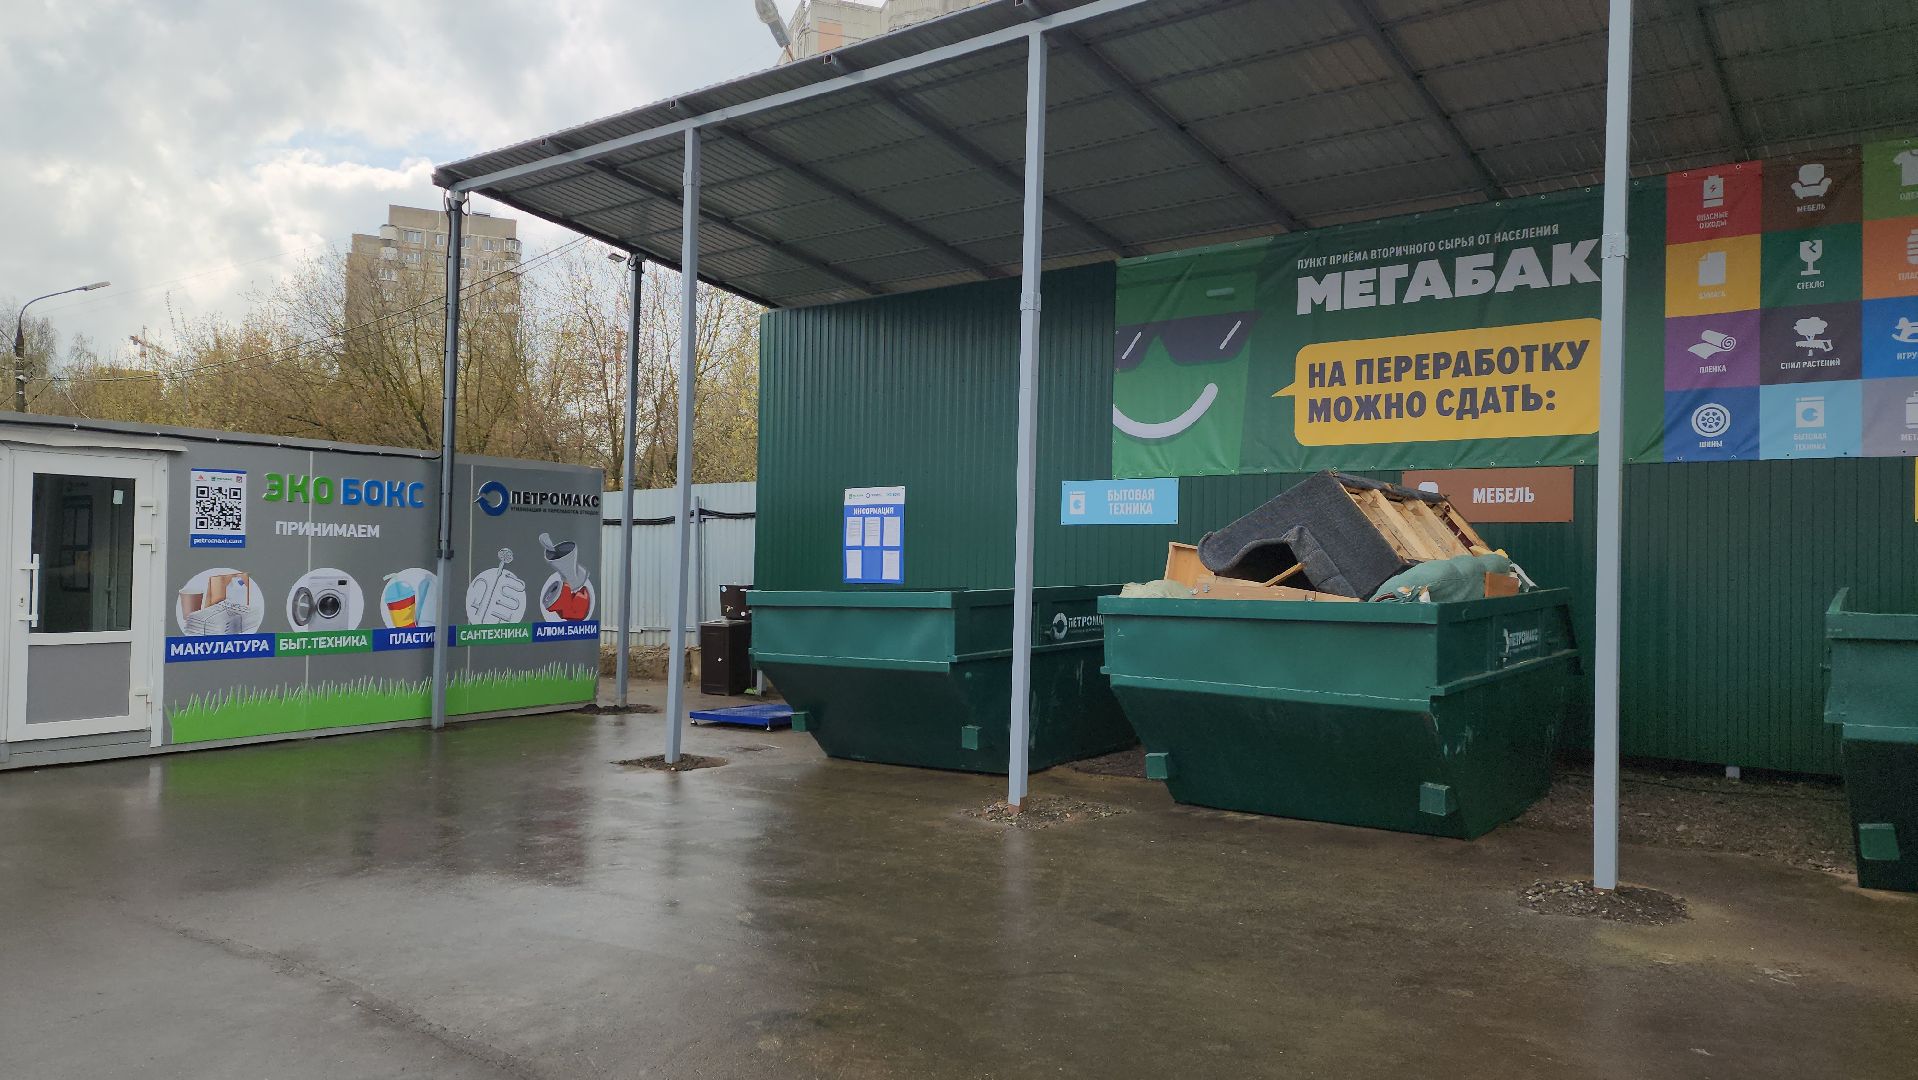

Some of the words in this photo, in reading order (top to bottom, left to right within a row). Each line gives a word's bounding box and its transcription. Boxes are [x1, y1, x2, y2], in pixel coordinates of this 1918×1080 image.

[1797, 203, 1826, 213] МЕБЕЛЬ
[1297, 256, 1328, 270] ПУНКТ
[1329, 250, 1369, 265] ПРИЁМА
[1370, 241, 1436, 259] ВТОРИЧНОГО
[1438, 235, 1475, 251] СЫРЬЯ
[1477, 233, 1491, 246] ОТ
[1494, 223, 1560, 243] НАСЕЛЕНИЯ
[1296, 238, 1602, 316] МЕГАБАК
[1797, 280, 1825, 290] СТЕКЛО
[1308, 360, 1347, 389] НА
[1355, 339, 1591, 386] ПЕРЕРАБОТКУ
[1780, 361, 1801, 370] СПИЛ
[1802, 357, 1841, 369] РАСТЕНИЙ
[1307, 391, 1428, 424] МОЖНО
[1435, 383, 1556, 421] СДАТЬ:
[1699, 440, 1723, 448] ШИНЫ
[262, 472, 334, 505] ЭКО
[340, 477, 425, 509] БОКС
[1107, 488, 1155, 502] БЫТОВАЯ
[1472, 486, 1535, 504] МЕБЕЛЬ
[510, 490, 600, 508] ПЕТРОМАКС
[853, 506, 894, 516] ИНФОРМАЦИЯ
[1109, 502, 1153, 516] ТЕХНИКА
[275, 520, 380, 538] ПРИНИМАЕМ
[1068, 615, 1104, 628] ПЕТРОМА
[460, 627, 529, 641] САНТЕХНИКА
[536, 624, 597, 637] АЛЮМ.БАНКИ
[279, 635, 369, 651] БЫТ.ТЕХНИКА
[389, 631, 436, 645] ПЛАСТИ
[170, 639, 270, 657] МАКУЛАТУРА
